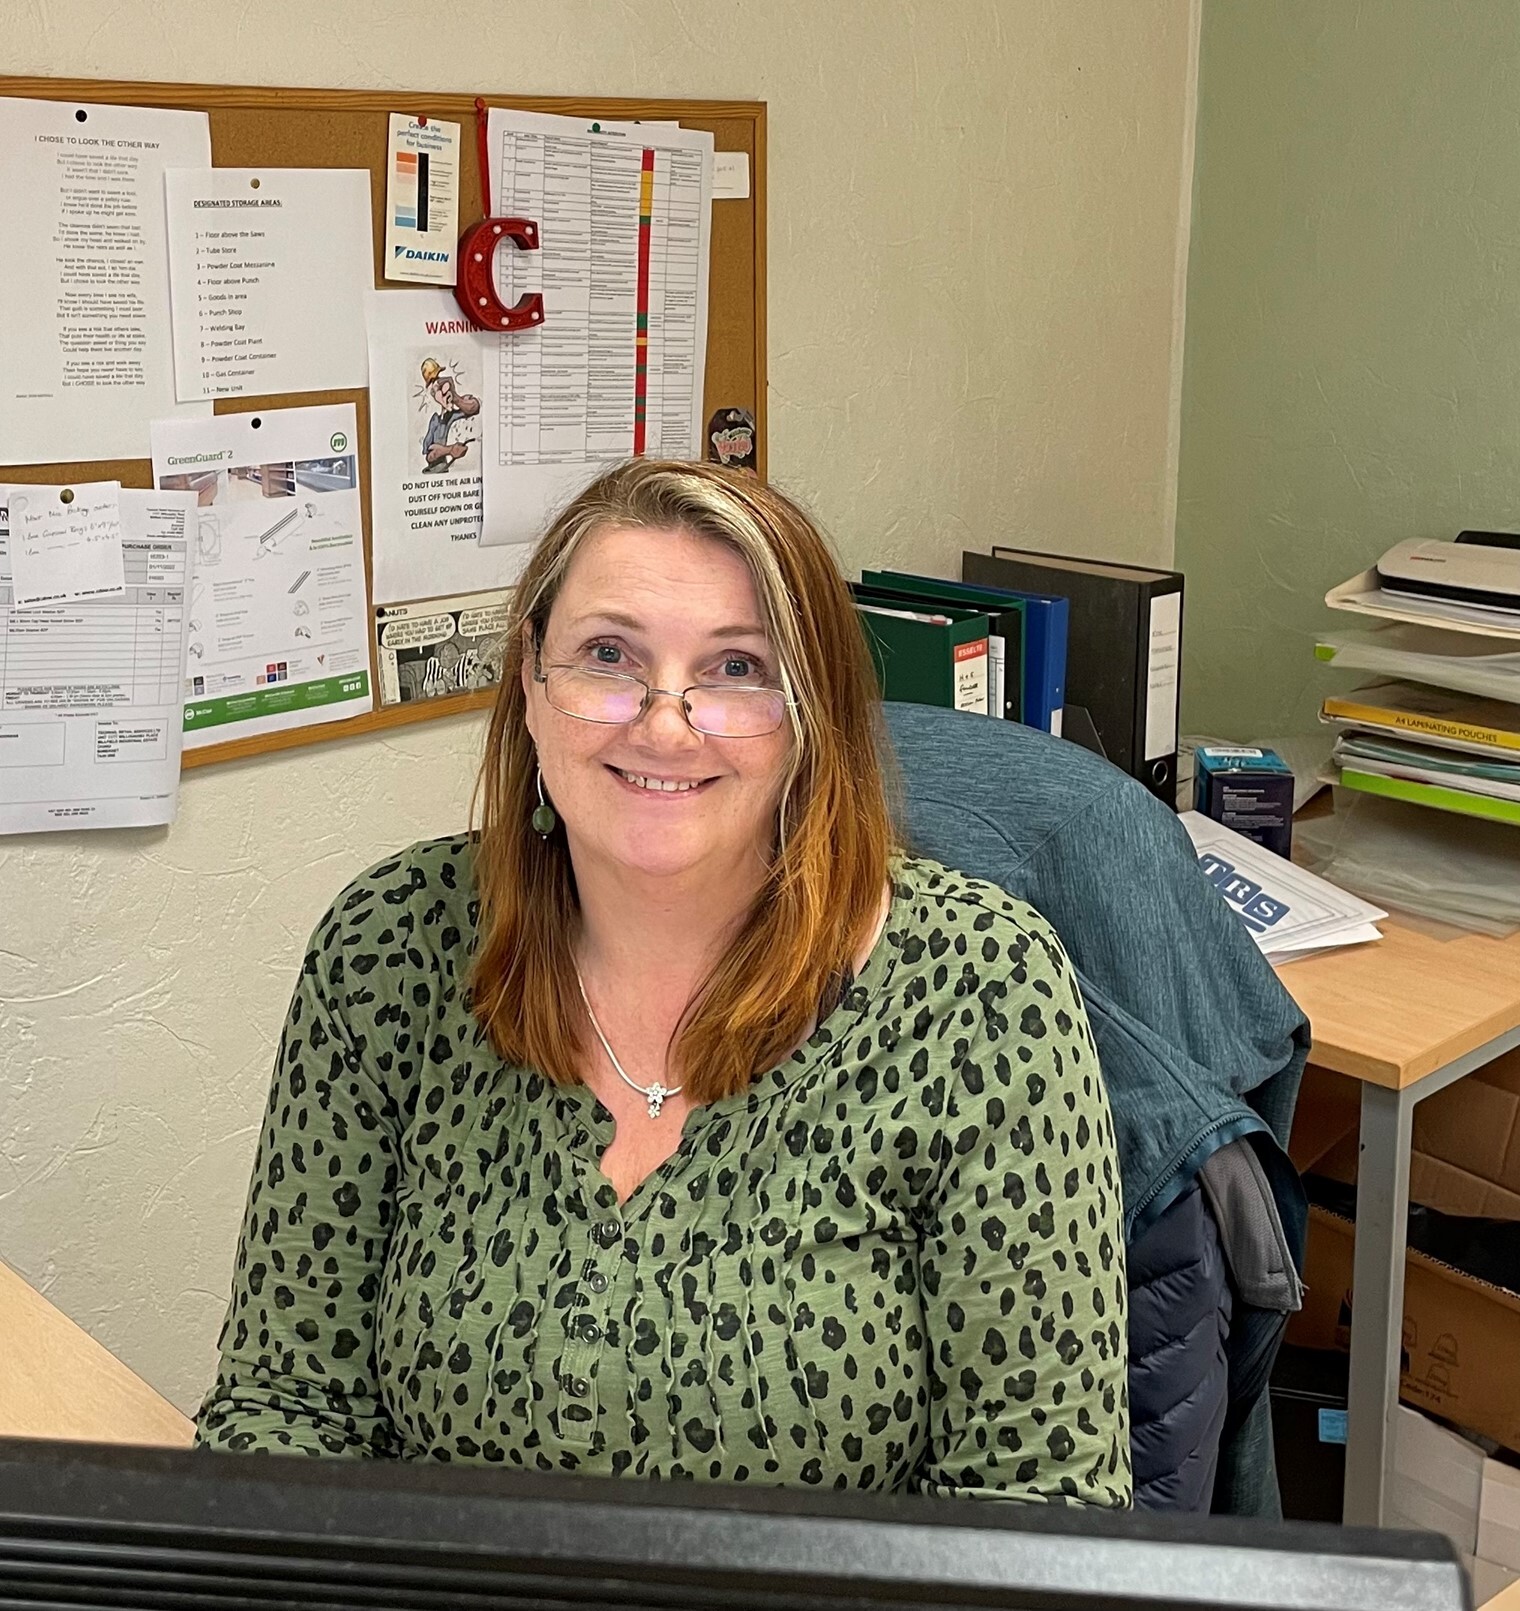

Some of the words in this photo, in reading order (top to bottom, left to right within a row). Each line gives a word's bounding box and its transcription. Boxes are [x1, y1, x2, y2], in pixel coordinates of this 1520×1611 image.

[408, 121, 429, 131] Cree
[38, 135, 64, 144] CHOSE
[78, 138, 100, 146] LOOK
[117, 140, 142, 148] OTHER
[397, 130, 419, 139] perfect
[421, 133, 452, 143] conditions
[417, 141, 442, 151] business
[193, 200, 231, 208] DESIGNATED
[406, 250, 449, 263] DAIKIN
[210, 324, 233, 332] Welding
[426, 321, 483, 334] WARNIN
[227, 369, 255, 377] Container
[415, 481, 429, 489] NOT
[431, 480, 444, 488] USE
[460, 477, 471, 485] AIR
[408, 495, 426, 503] DUST
[428, 493, 441, 501] OFF
[442, 492, 461, 500] YOUR
[404, 507, 438, 517] YOURSELF
[440, 505, 462, 513] DOWN
[463, 503, 473, 511] OR
[411, 521, 433, 530] CLEAN
[451, 532, 477, 542] THANKS
[1395, 716, 1405, 724] A4
[1407, 718, 1457, 735] LAMINATING
[1458, 728, 1497, 742] POUCHES
